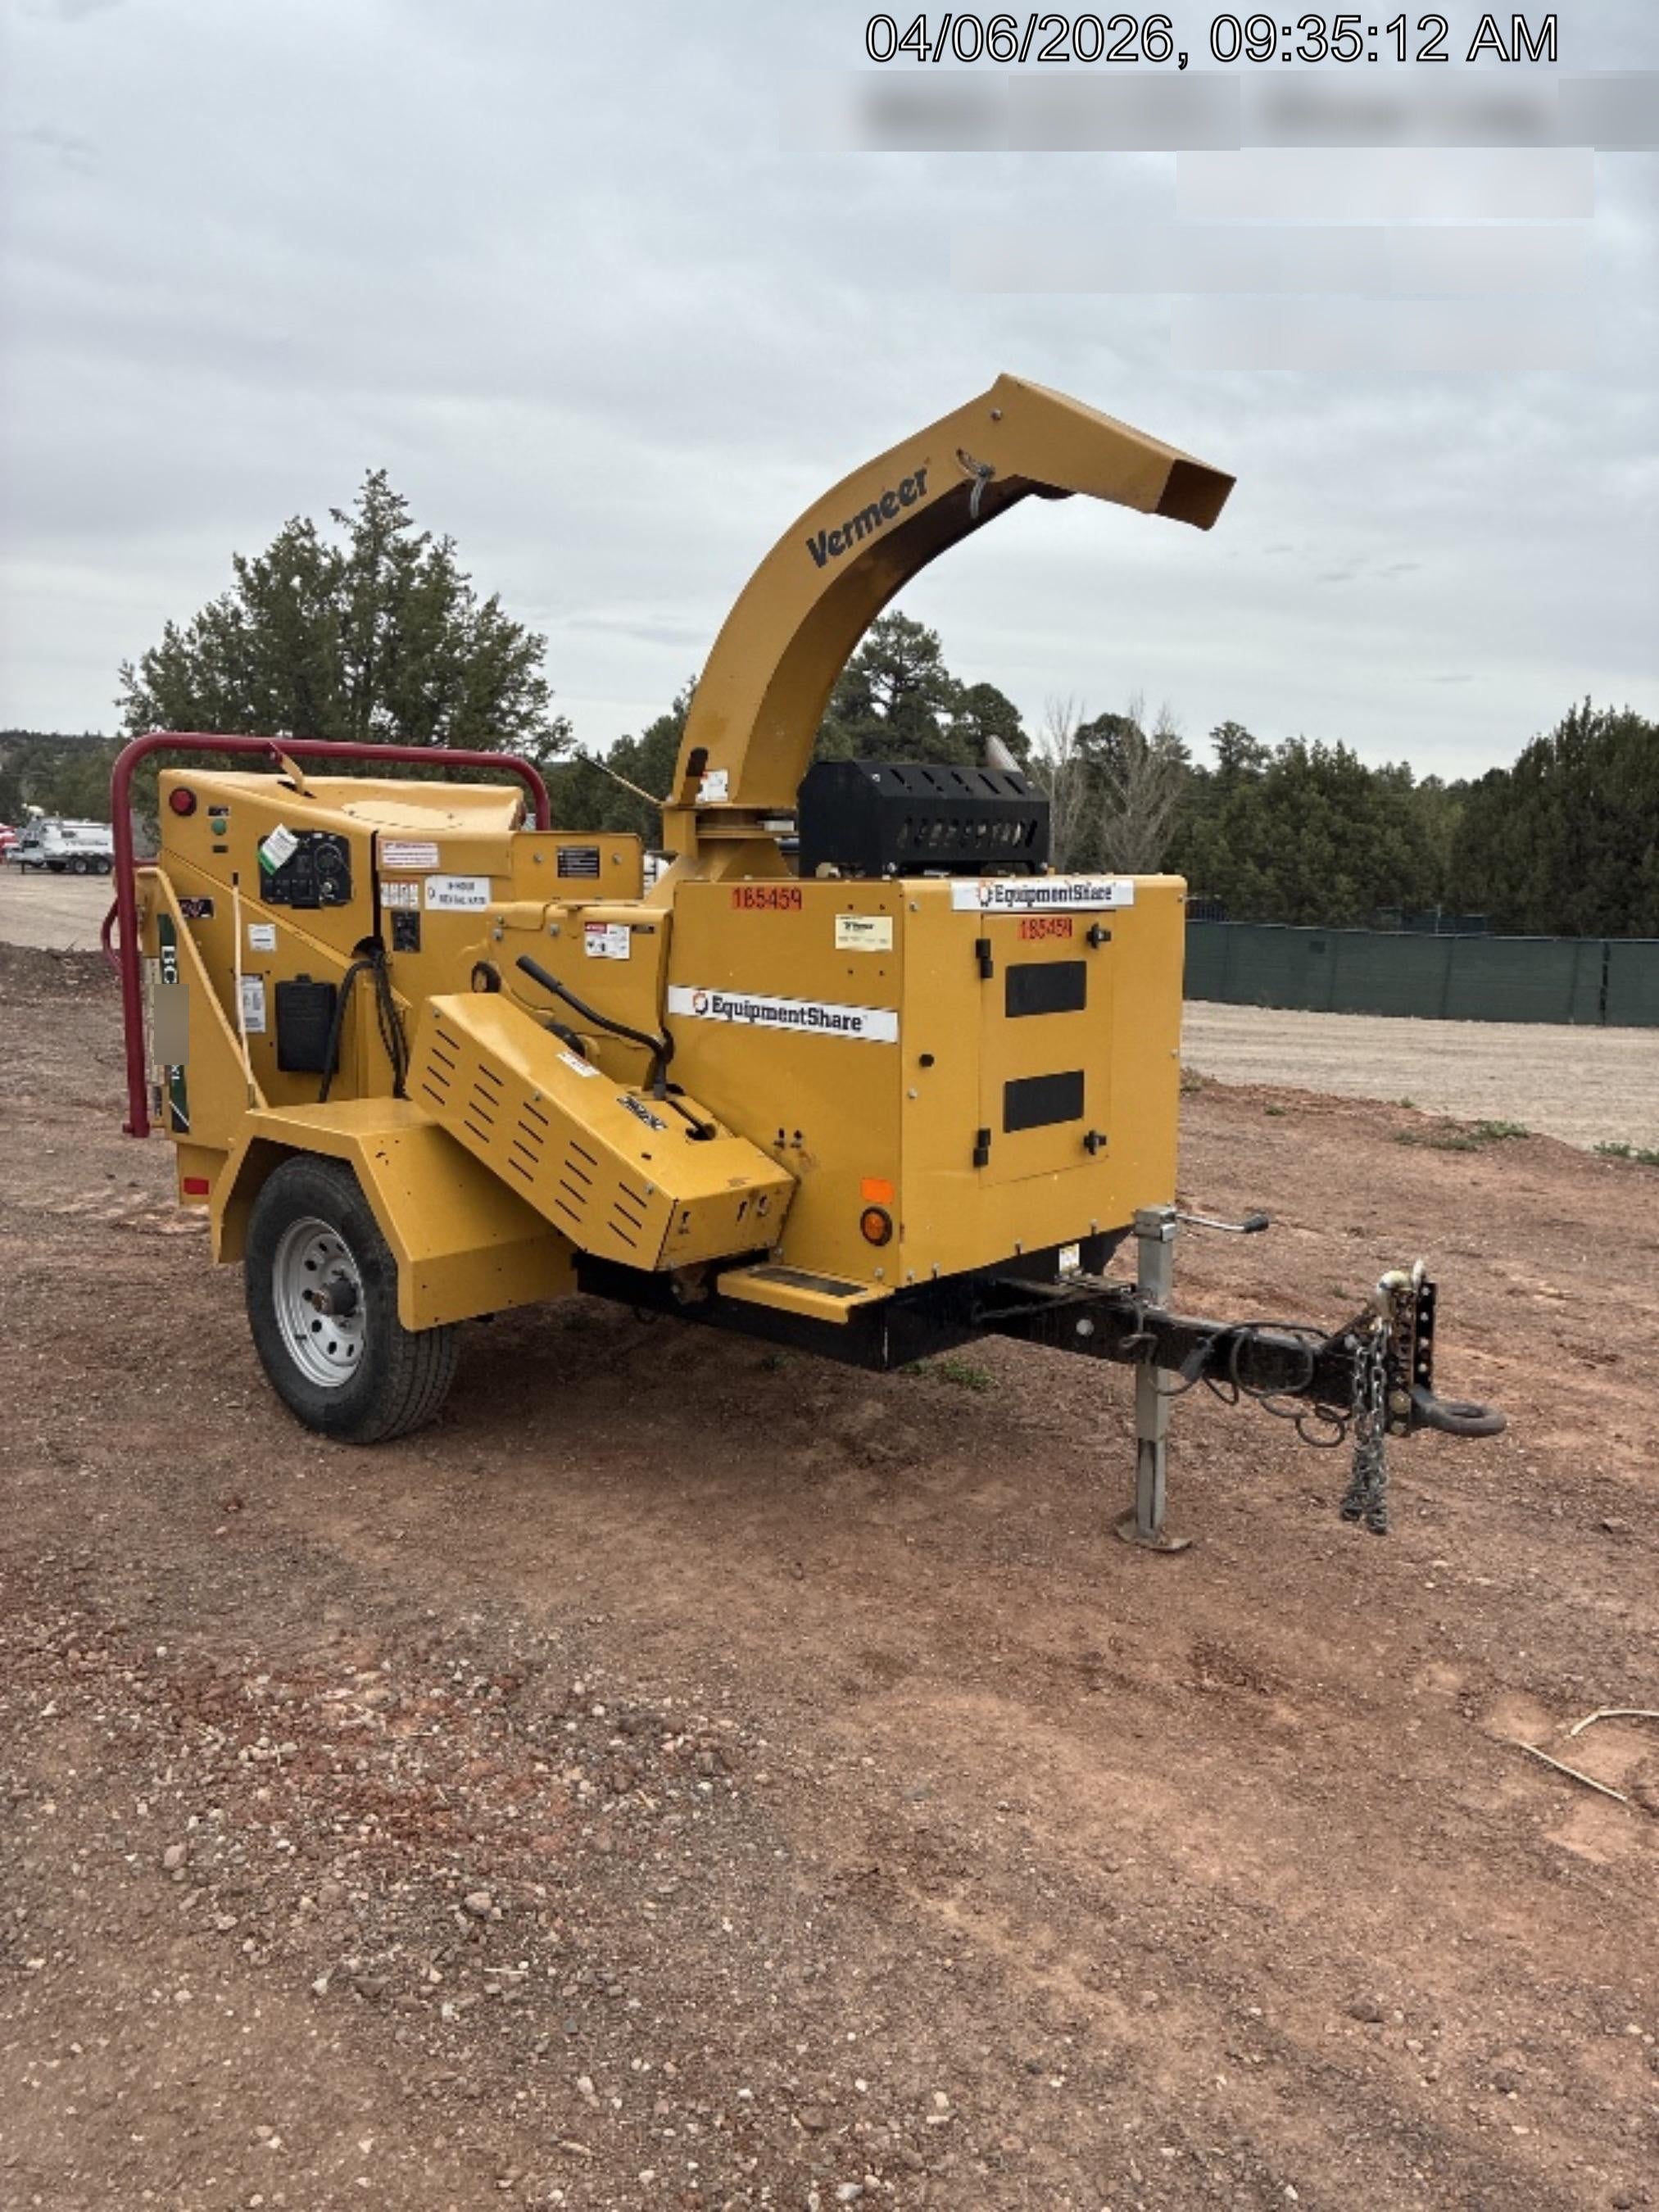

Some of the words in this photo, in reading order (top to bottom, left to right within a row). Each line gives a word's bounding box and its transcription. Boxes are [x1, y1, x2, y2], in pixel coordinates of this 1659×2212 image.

[805, 468, 927, 569] Vermeer
[995, 882, 1112, 907] EquipmentShare
[712, 995, 862, 1032] EquipmentShare
